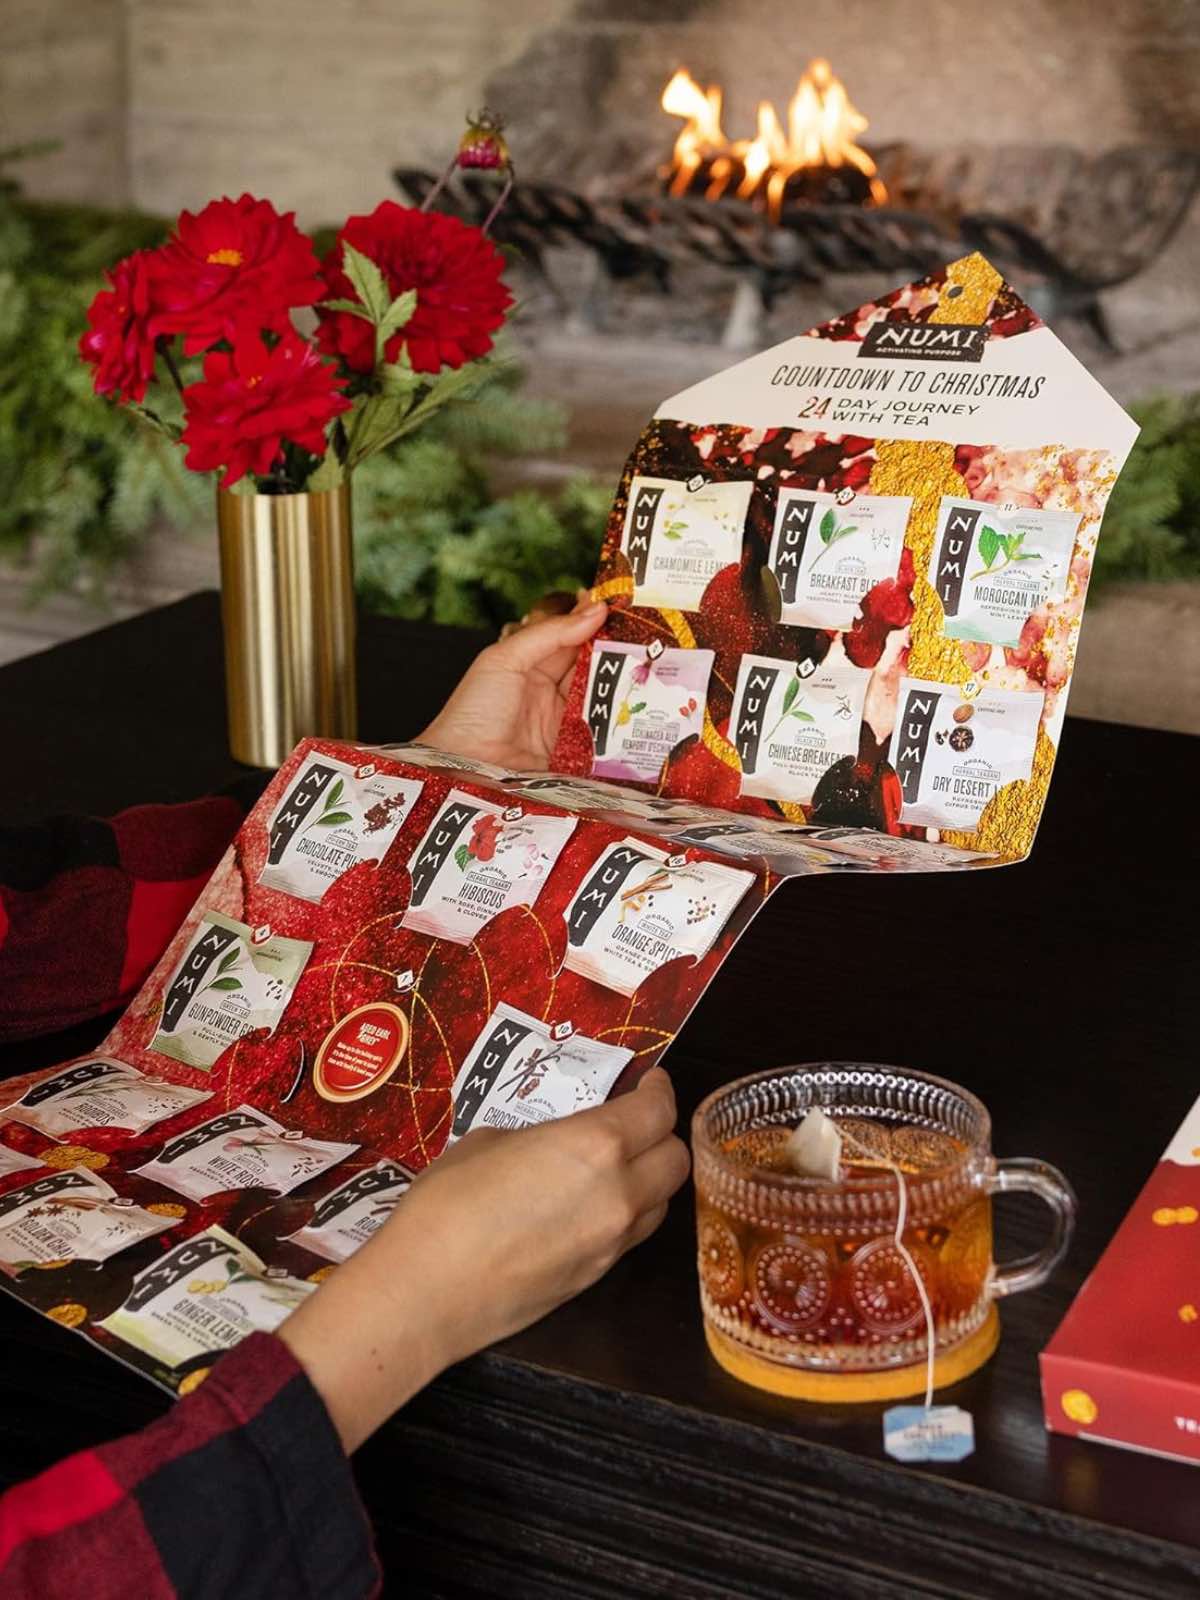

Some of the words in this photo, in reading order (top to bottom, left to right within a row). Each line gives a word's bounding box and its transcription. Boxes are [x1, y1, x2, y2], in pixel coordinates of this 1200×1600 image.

[876, 328, 979, 347] NUMI
[771, 365, 895, 391] COUNTDOWN
[898, 370, 926, 392] TO
[928, 372, 1046, 399] CHRISTMAS
[797, 396, 833, 419] 24
[838, 398, 877, 410] DAY
[883, 401, 980, 416] JOURNEY
[832, 411, 884, 424] WITH
[892, 414, 929, 426] TEA
[629, 493, 658, 574] NUMI
[778, 507, 808, 590] NUMI
[940, 516, 972, 601] NUMI
[810, 573, 858, 591] BREAKFAST
[974, 585, 1028, 607] MOROCCAN
[591, 660, 619, 742] NUMI
[739, 674, 771, 759] NUMI
[768, 743, 802, 762] CHINESE
[900, 698, 932, 787] NUMI
[932, 776, 952, 792] DRY
[953, 778, 991, 798] DESERT
[271, 771, 328, 849] NUMI
[296, 838, 344, 865] CHOCOLATE
[413, 810, 469, 891] NUMI
[458, 882, 506, 909] HIBISCUS
[574, 850, 640, 928] NUMI
[611, 924, 653, 953] ORANGE
[166, 935, 227, 1016] NUMI
[188, 1002, 241, 1035] GUNPOWDER
[32, 1063, 115, 1098] NUMI
[457, 1028, 520, 1119] NUMI
[168, 1115, 255, 1156] NUMI
[208, 1154, 242, 1175] WHITE
[317, 1169, 403, 1219] NUMI
[134, 1241, 226, 1299] NUMI
[173, 1299, 217, 1327] GINGER
